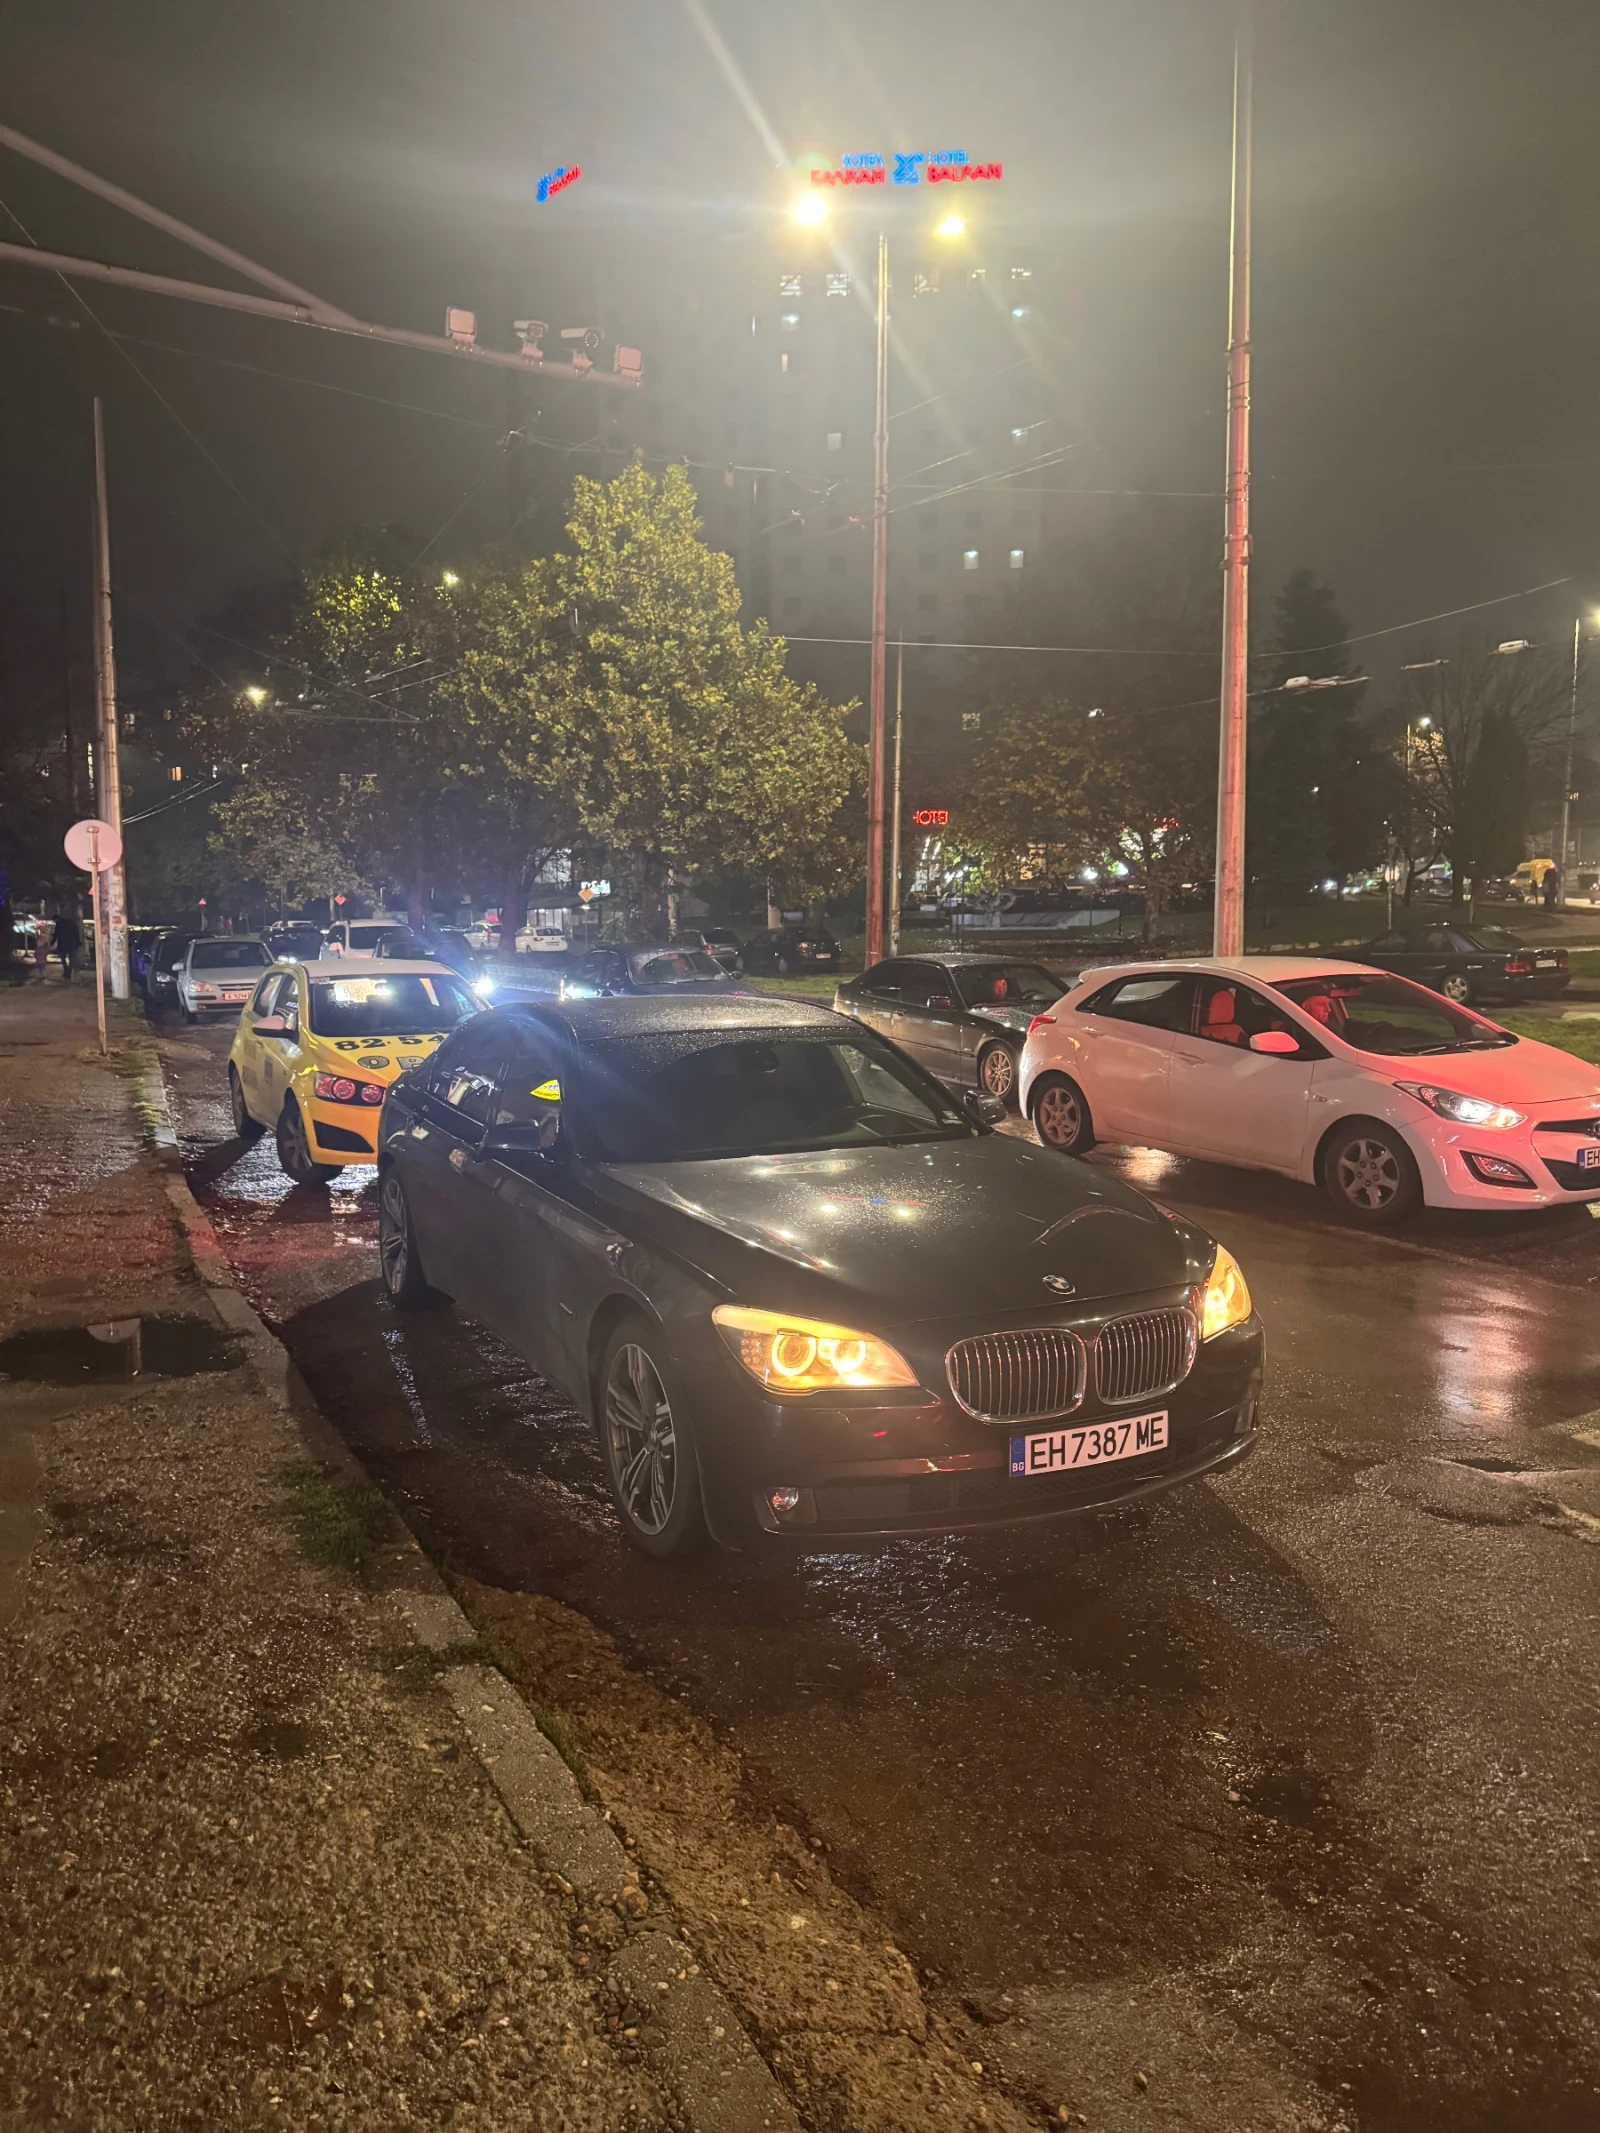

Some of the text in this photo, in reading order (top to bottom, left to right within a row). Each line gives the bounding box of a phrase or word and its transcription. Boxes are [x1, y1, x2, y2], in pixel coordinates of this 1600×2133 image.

[927, 161, 1003, 184] BALKAN
[1030, 1415, 1164, 1470] EH 7387 ME
[1012, 1462, 1025, 1472] BG
